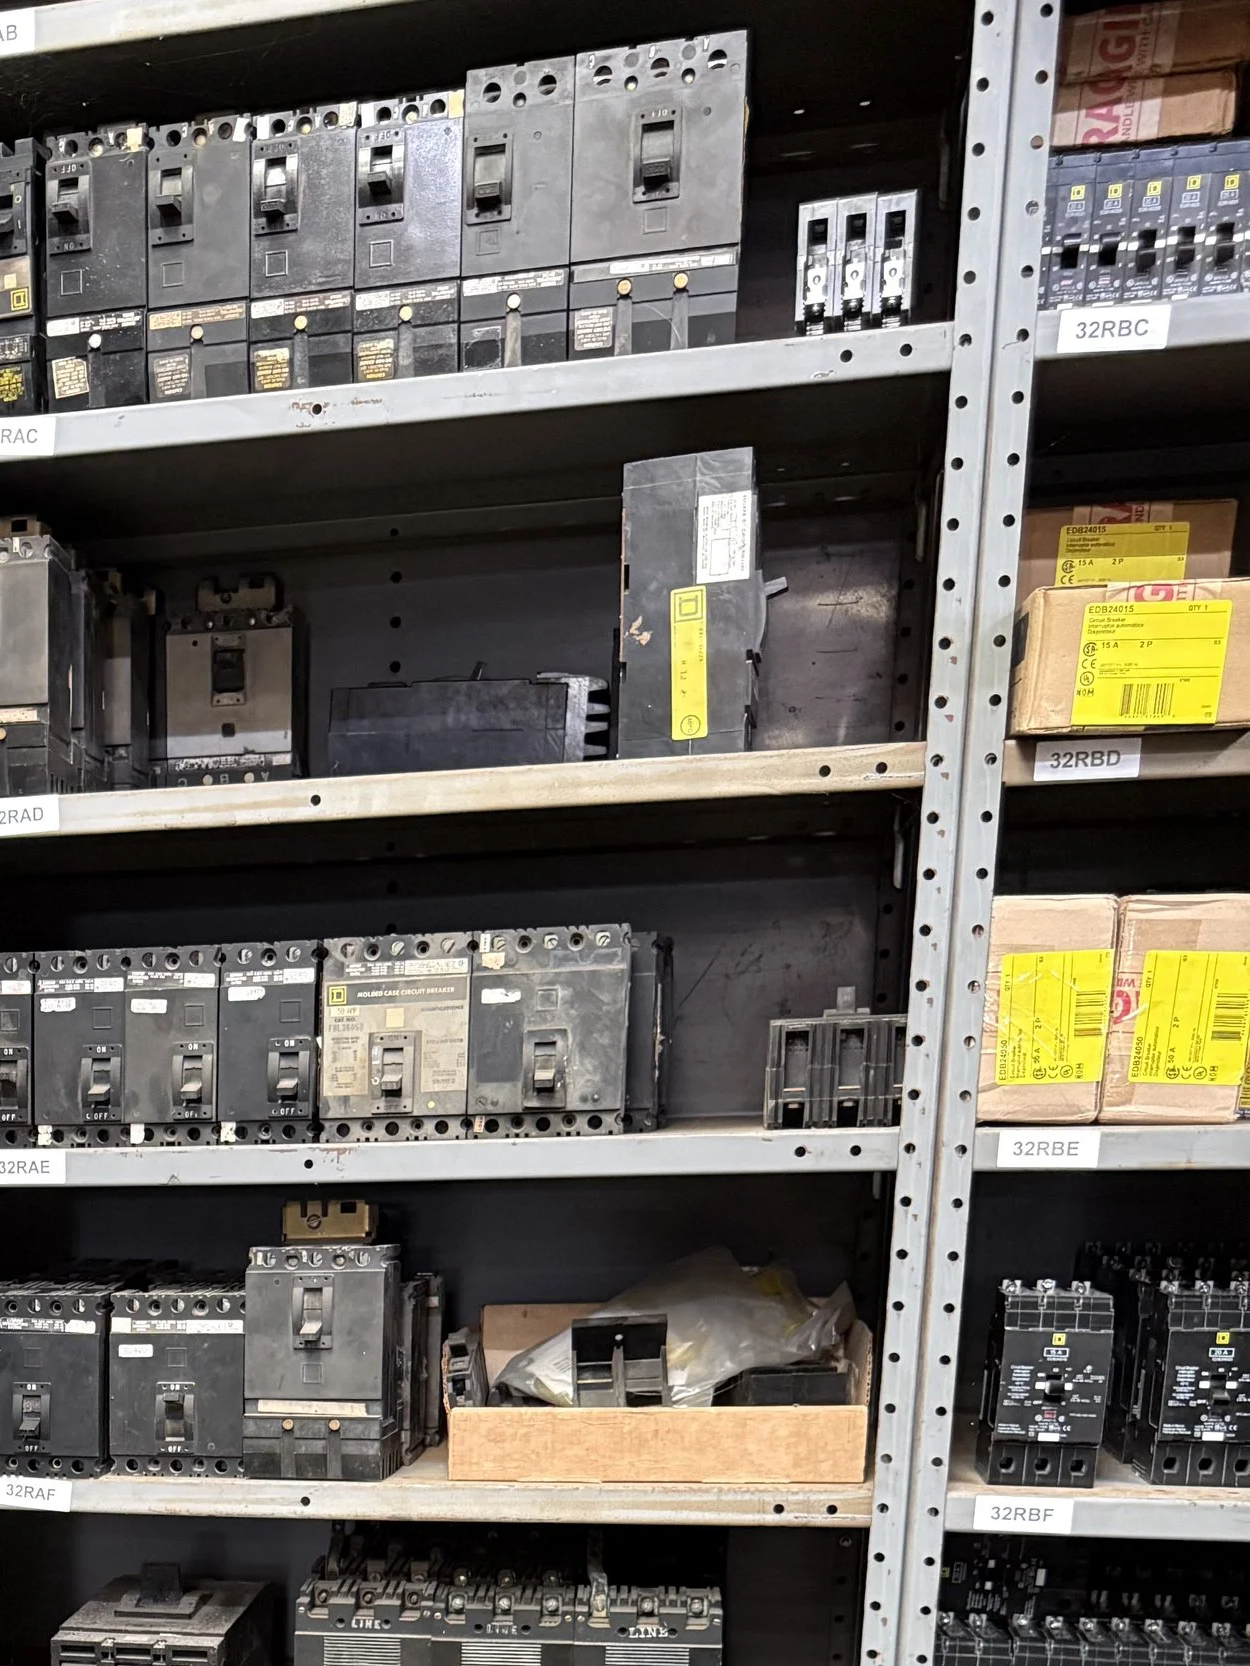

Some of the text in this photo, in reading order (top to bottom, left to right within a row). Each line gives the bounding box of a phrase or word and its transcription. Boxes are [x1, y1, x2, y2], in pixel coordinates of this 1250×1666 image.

[1076, 319, 1148, 339] 32RBC
[1066, 526, 1107, 535] EDB24015
[1089, 605, 1134, 613] EDB24015
[1050, 750, 1121, 769] 32RBD
[357, 989, 383, 998] MOLDED
[401, 988, 425, 996] CIRCUIT
[427, 986, 455, 995] BREAKER
[1131, 1037, 1143, 1078] EDB24050
[1168, 1054, 1175, 1063] 50
[1013, 1142, 1079, 1156] 32RBE
[0, 1161, 49, 1174] 32RAE
[6, 1484, 55, 1500] 32RAF
[991, 1507, 1054, 1522] 32RBF
[351, 1619, 381, 1629] LINE
[629, 1626, 669, 1638] LINE
